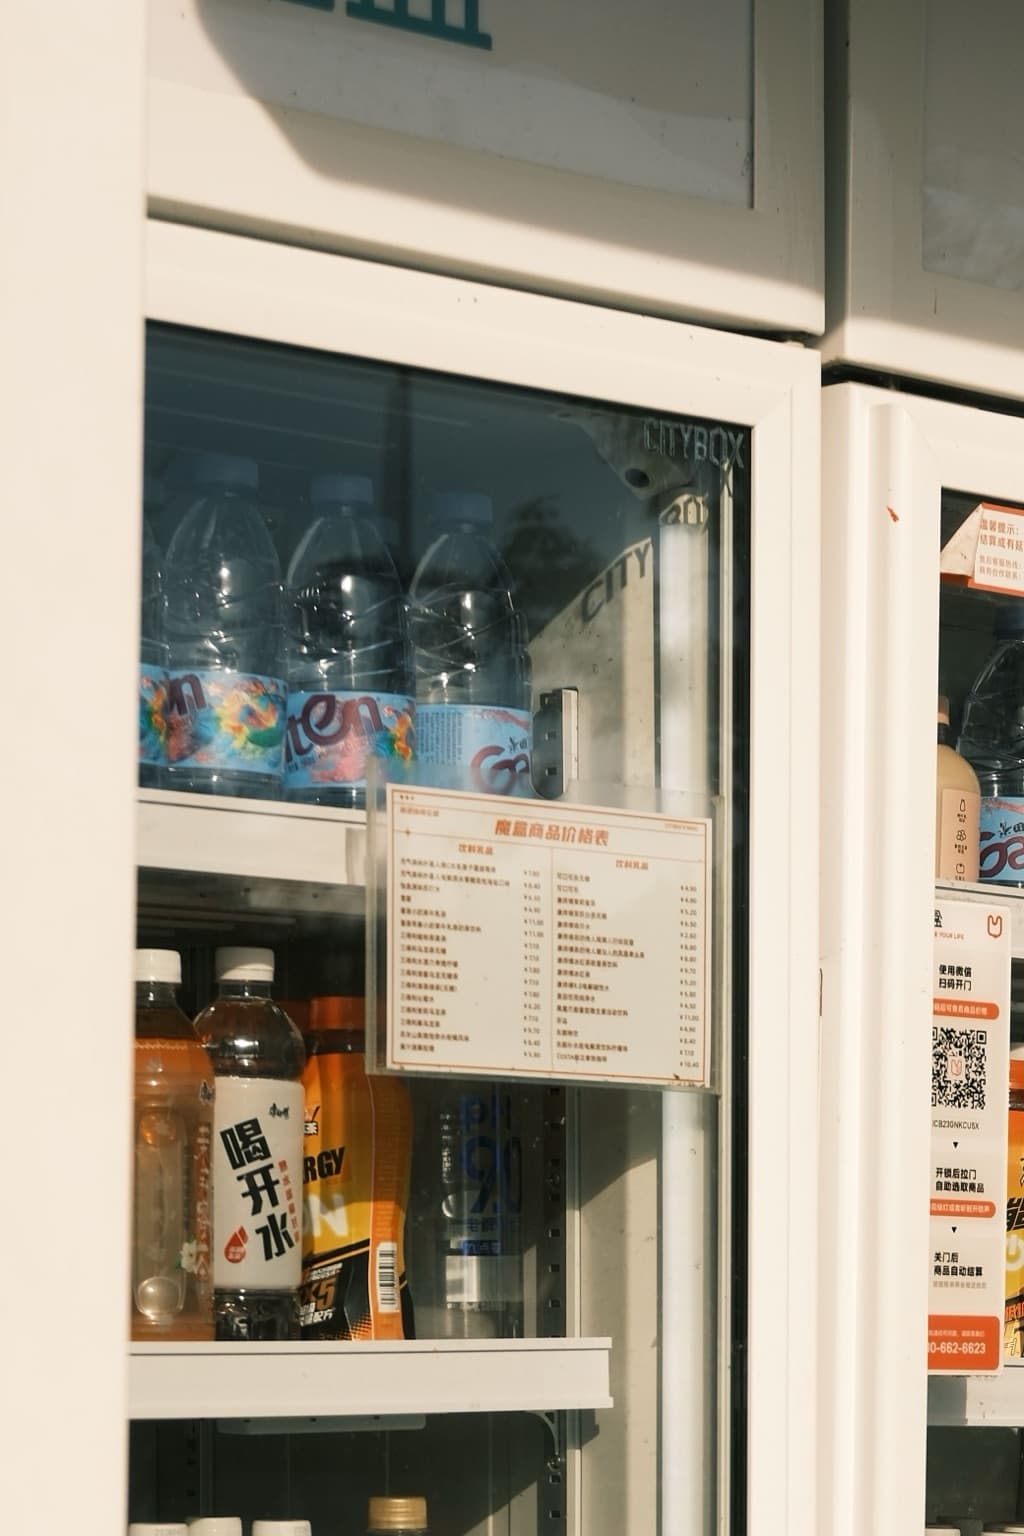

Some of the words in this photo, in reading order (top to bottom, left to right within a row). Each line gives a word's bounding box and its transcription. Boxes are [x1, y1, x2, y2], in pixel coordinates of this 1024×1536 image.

[494, 819, 609, 846] 魔盒商品价格表
[939, 964, 971, 977] 使用微信
[939, 978, 971, 991] 扫码开门
[935, 1167, 976, 1180] 开锁后拉门
[220, 1117, 295, 1262] 喝开水
[935, 1181, 984, 1193] 自助选取商品
[934, 1252, 959, 1263] 关门后
[933, 1265, 983, 1277] 商品自动结算
[928, 1342, 986, 1355] 0-662-6623
